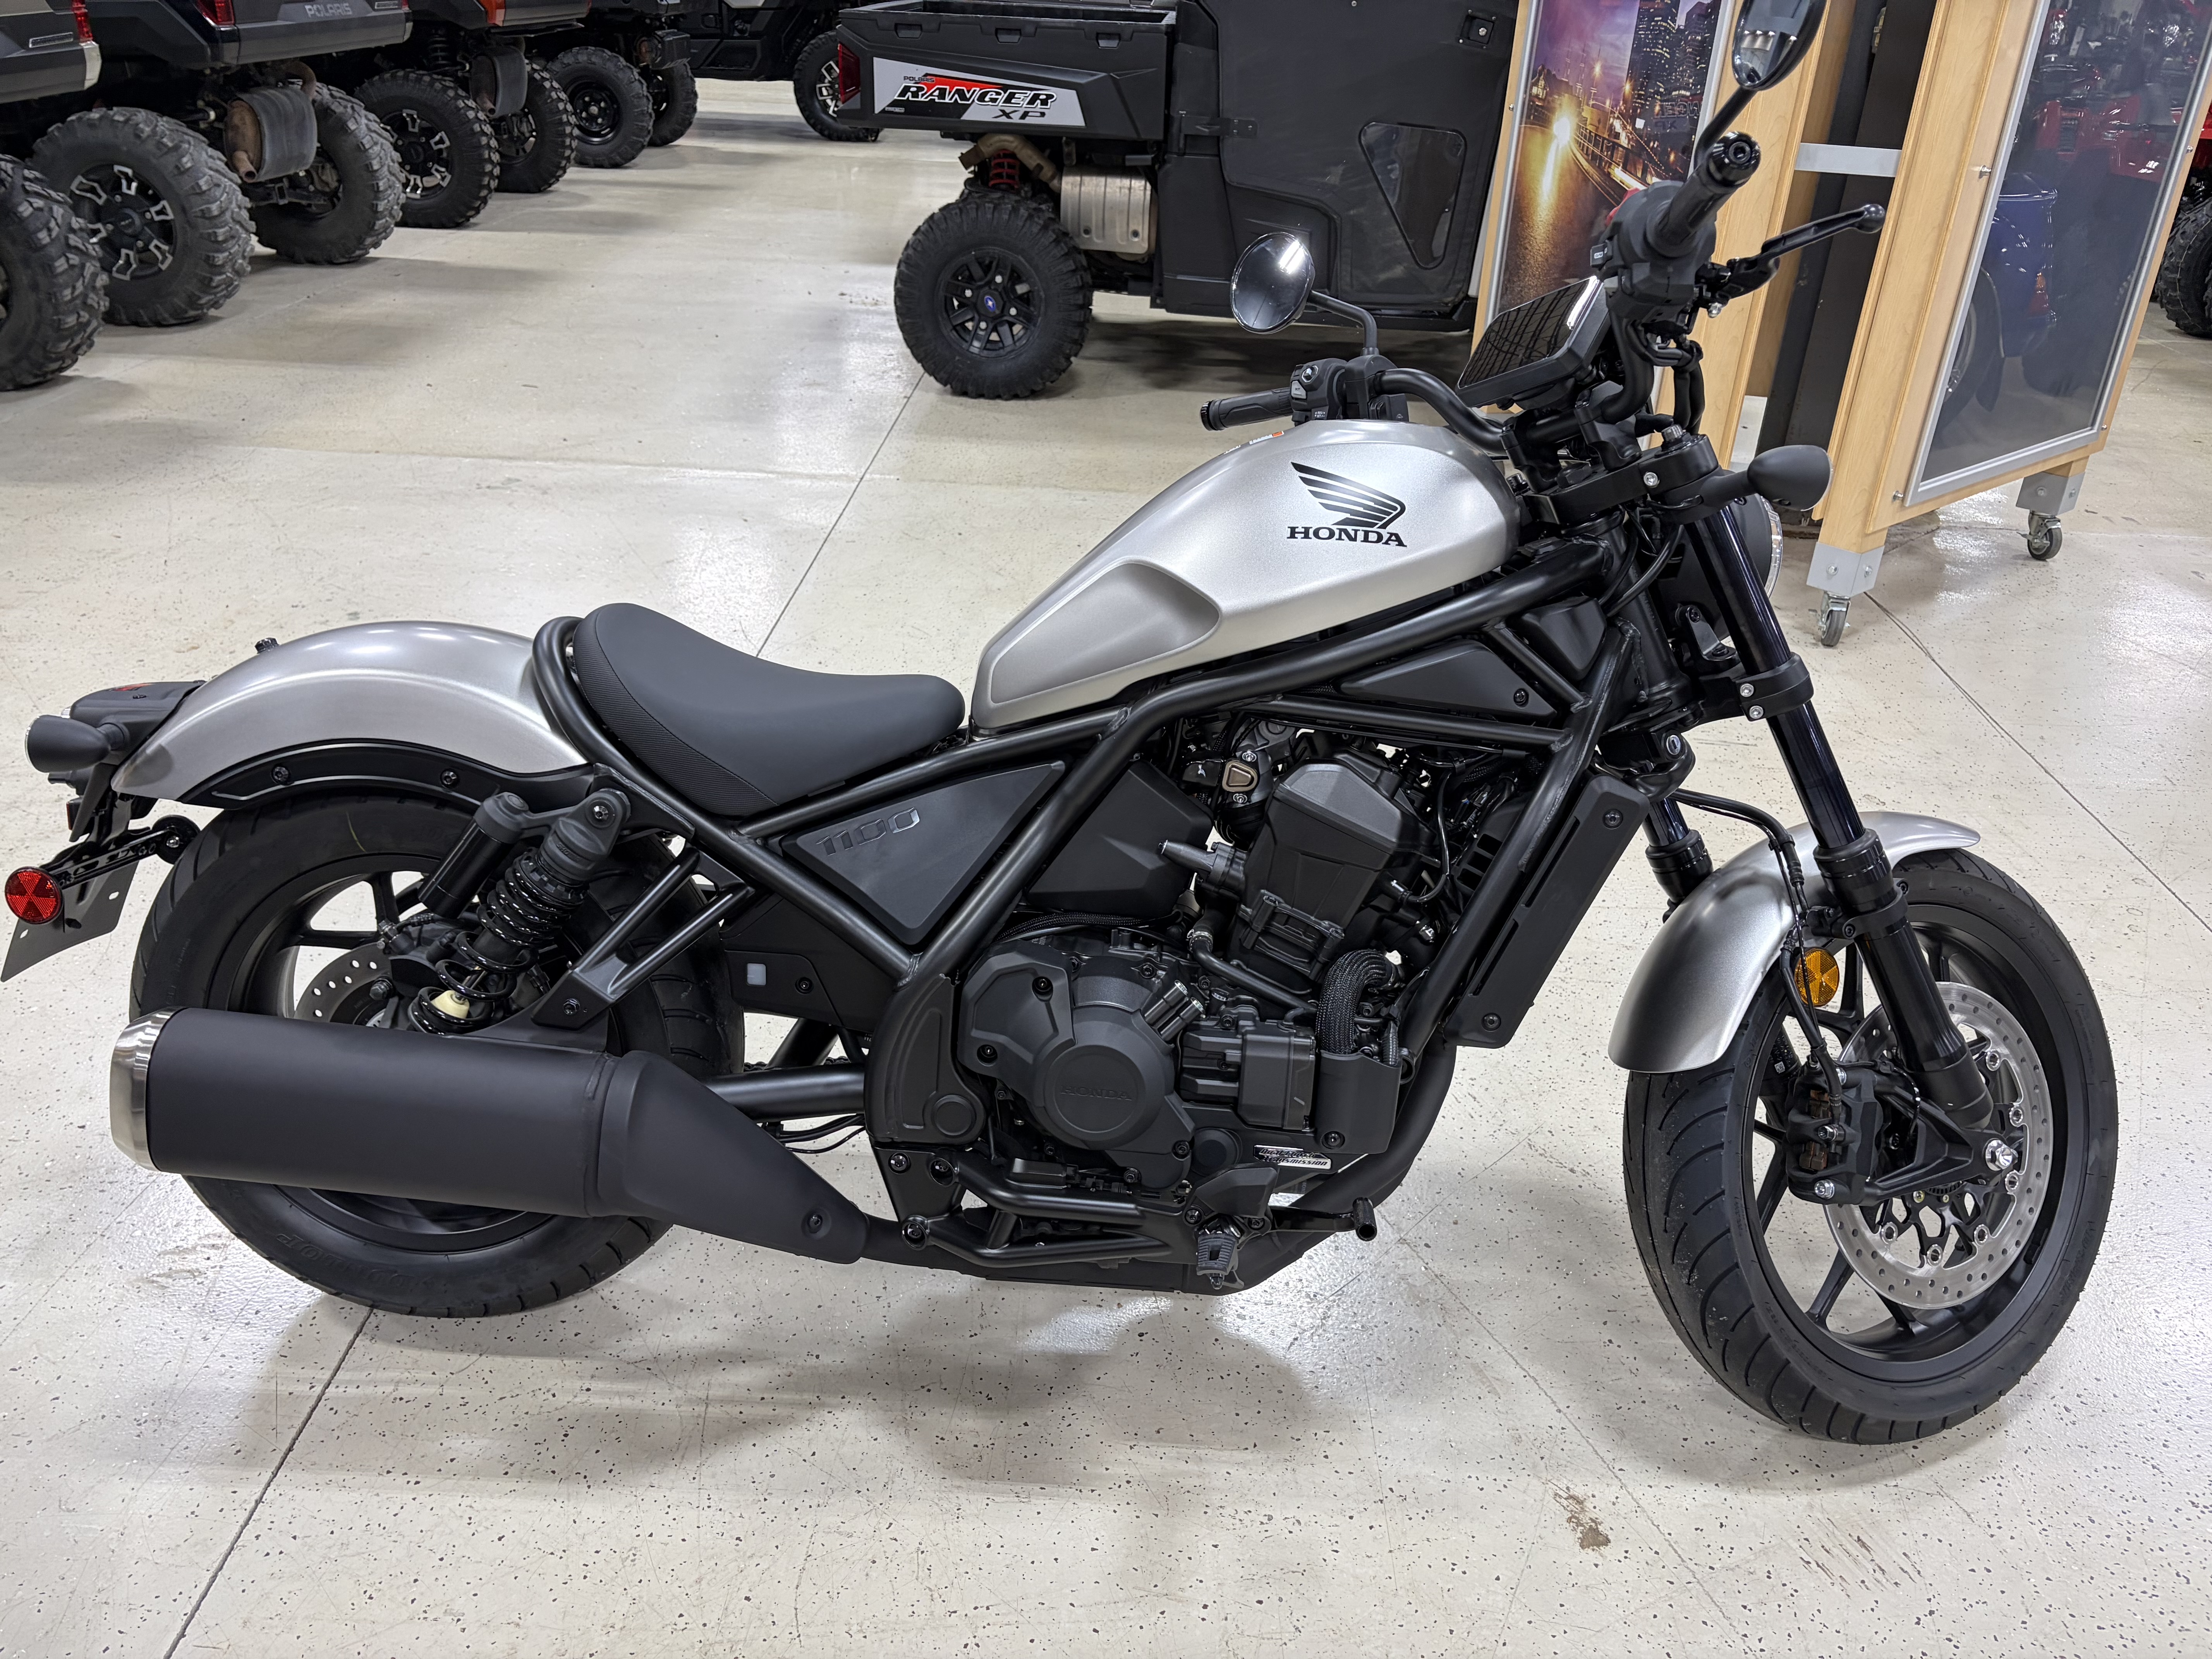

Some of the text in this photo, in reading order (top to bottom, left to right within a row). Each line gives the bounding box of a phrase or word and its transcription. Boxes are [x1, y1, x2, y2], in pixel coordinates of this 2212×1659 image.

[304, 3, 352, 17] POLARIS
[894, 84, 1057, 108] RANGER
[992, 109, 1046, 120] XP
[1286, 526, 1407, 547] HONDA
[816, 807, 920, 856] 1100
[1060, 1086, 1132, 1101] HONDA
[1262, 1156, 1328, 1166] Transmission
